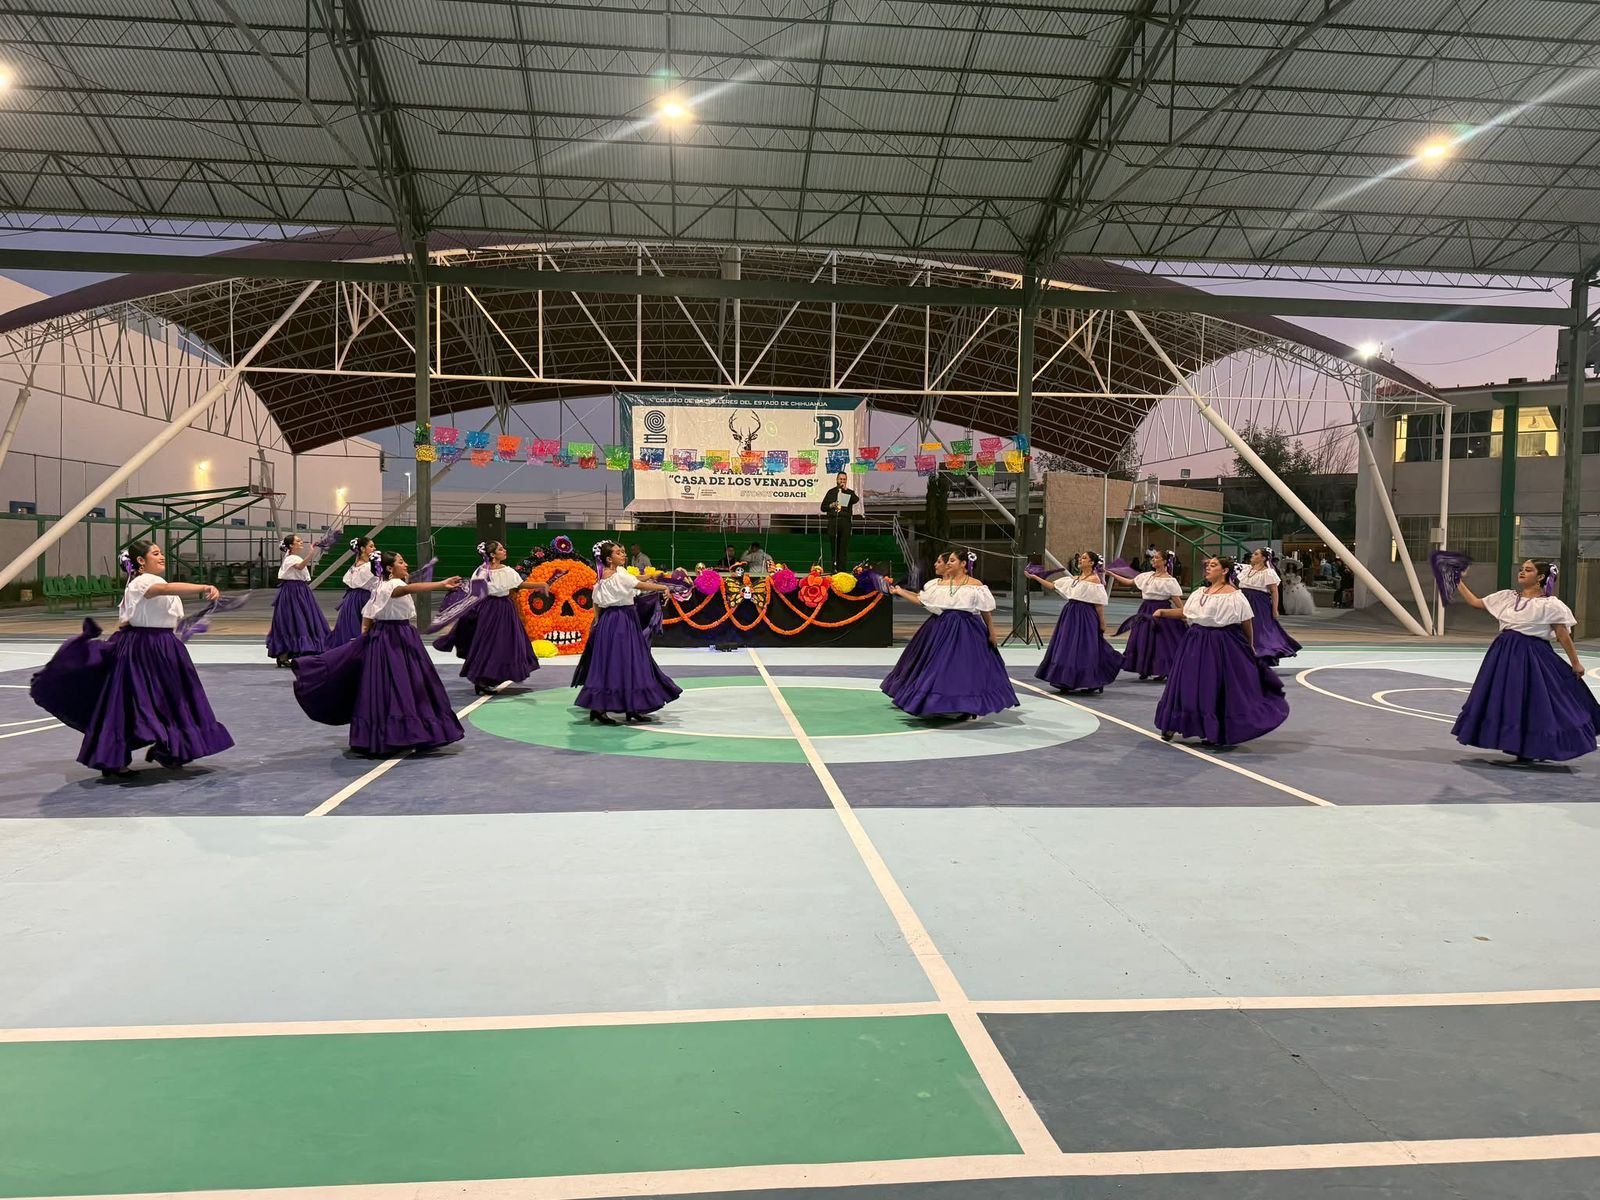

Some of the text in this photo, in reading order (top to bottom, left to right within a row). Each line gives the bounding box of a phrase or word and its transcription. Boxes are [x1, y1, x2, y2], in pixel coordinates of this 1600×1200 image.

[814, 414, 843, 447] B
[709, 477, 725, 486] DE
[727, 477, 751, 486] LOS
